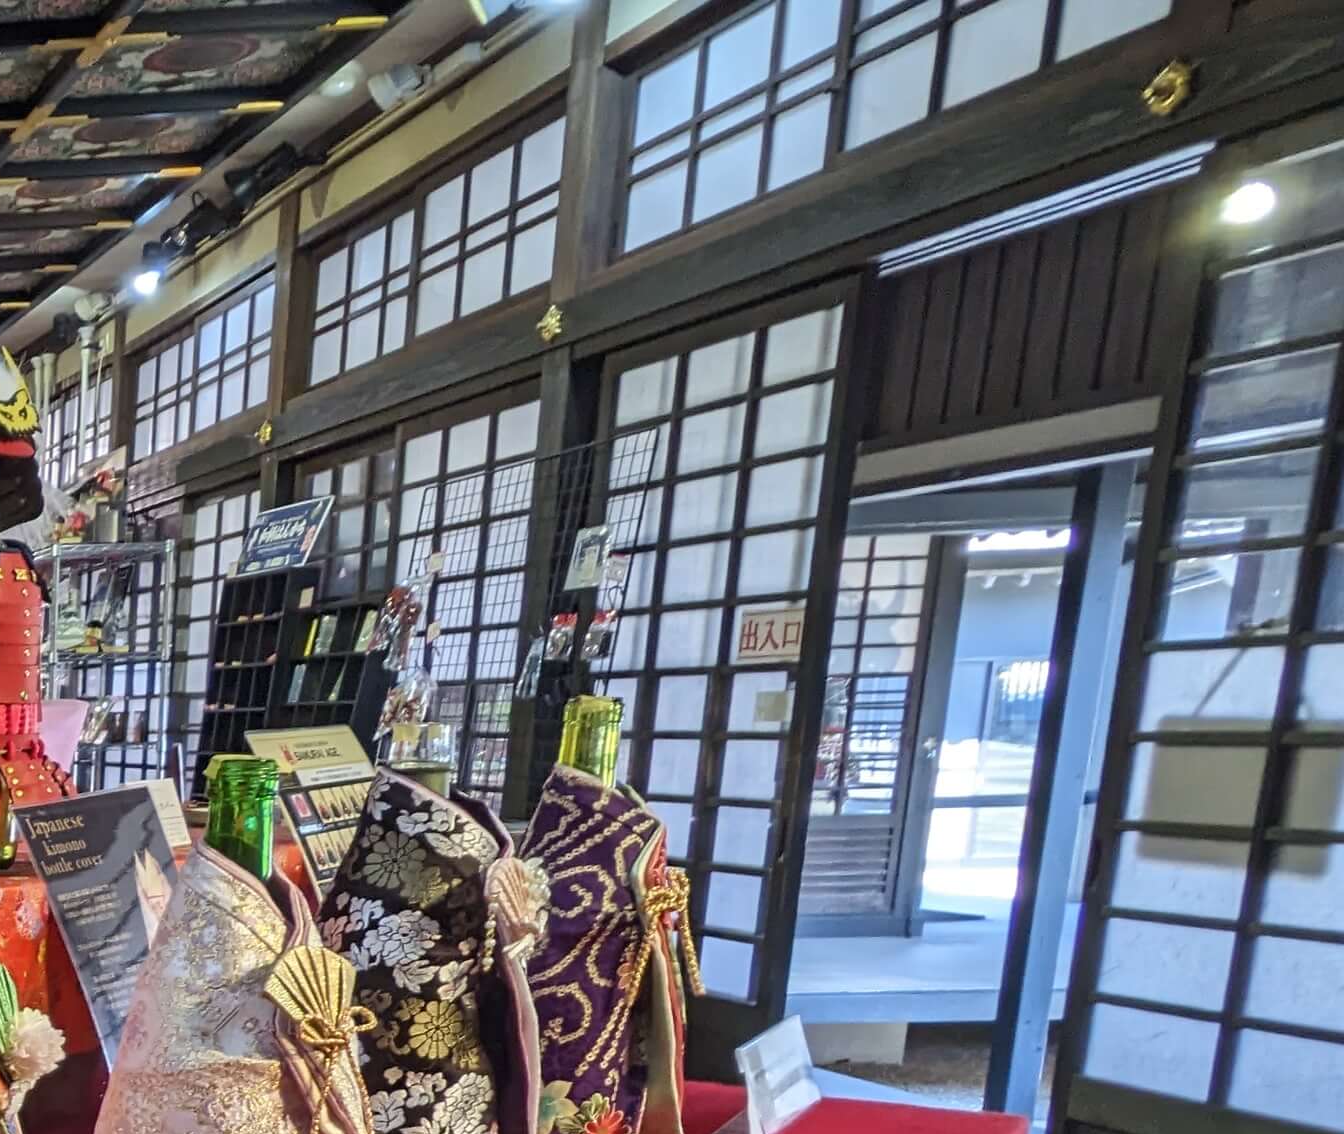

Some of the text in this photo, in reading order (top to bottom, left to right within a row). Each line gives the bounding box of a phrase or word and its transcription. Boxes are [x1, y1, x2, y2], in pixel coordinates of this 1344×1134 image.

[739, 619, 801, 653] 出入口
[25, 814, 85, 840] Japanese
[42, 838, 87, 856] kimono
[40, 853, 104, 876] bottle cover
